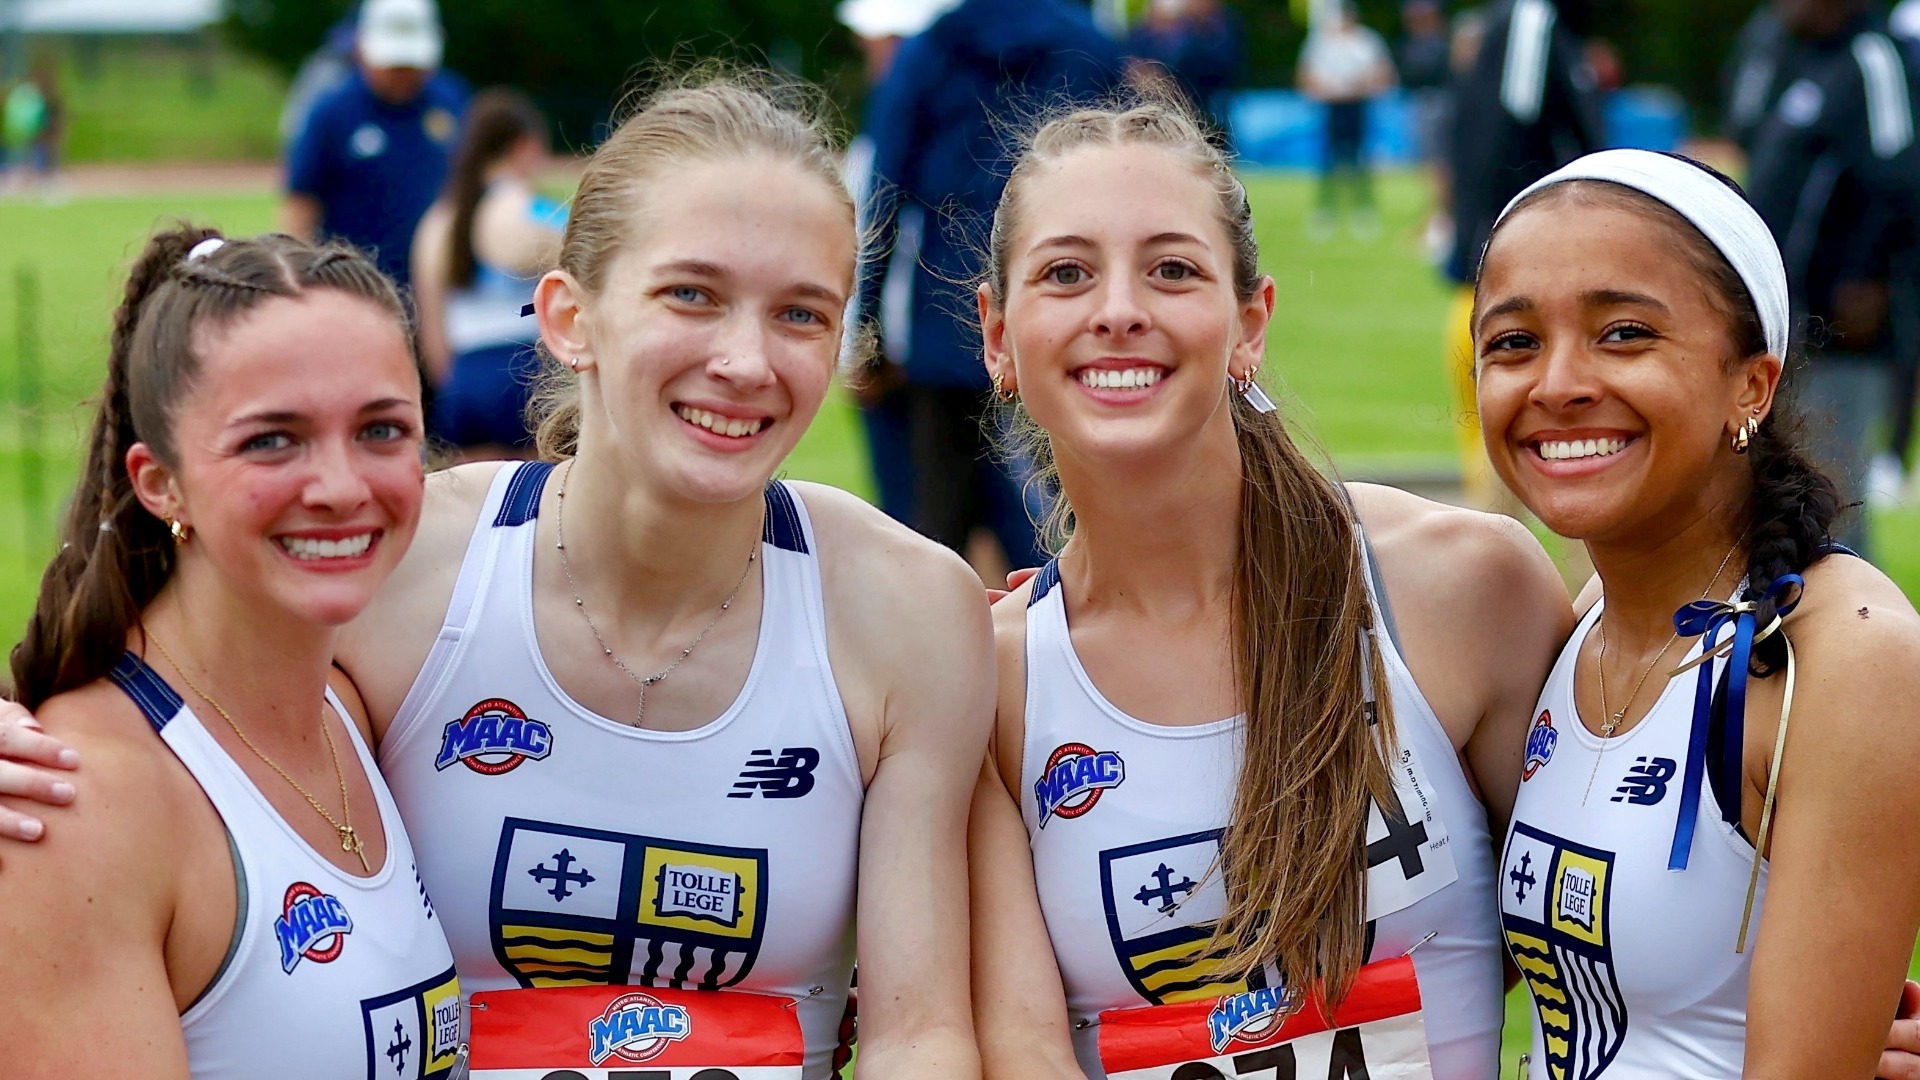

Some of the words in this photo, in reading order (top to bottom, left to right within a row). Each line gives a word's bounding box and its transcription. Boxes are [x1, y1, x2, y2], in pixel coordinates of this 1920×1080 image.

[473, 703, 492, 715] METRO
[494, 702, 521, 717] ATLANTIC
[437, 716, 551, 769] MAAC
[1064, 746, 1090, 755] ATLANTIC
[466, 757, 488, 772] ATHLETIC
[726, 747, 820, 799] NB
[1036, 754, 1122, 827] MAAC
[1610, 756, 1677, 807] NB
[1429, 838, 1447, 852] Heat
[669, 870, 732, 895] TOLLE
[1566, 873, 1591, 897] TOLLE
[672, 890, 725, 913] LEGE
[1564, 893, 1586, 916] LEGE
[277, 896, 349, 971] MAAC
[630, 996, 656, 1006] ATLANTIC
[436, 1002, 459, 1027] TOLLE
[439, 1024, 458, 1046] LEGE
[592, 1006, 688, 1063] MAAC
